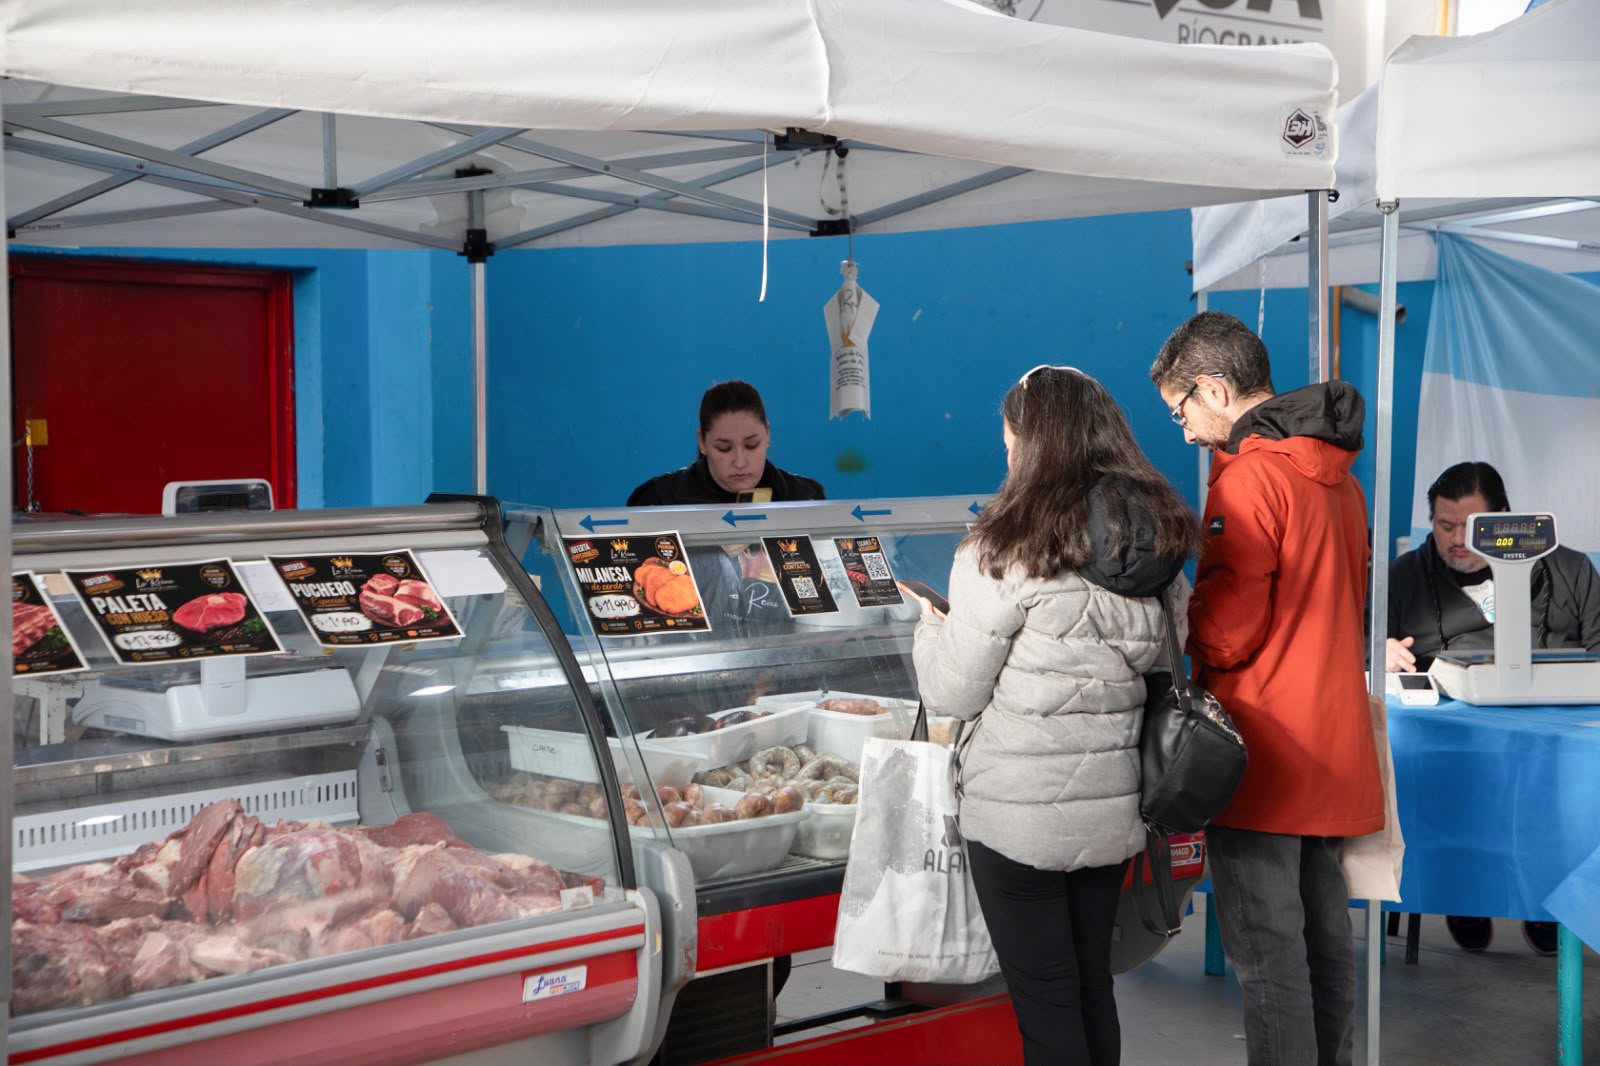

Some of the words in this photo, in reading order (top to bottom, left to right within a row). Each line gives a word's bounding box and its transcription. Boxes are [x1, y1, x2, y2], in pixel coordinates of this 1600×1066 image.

[575, 566, 632, 583] MILANESA
[289, 581, 356, 598] PUCHERO
[591, 582, 601, 590] de
[602, 580, 624, 590] cerdo
[91, 593, 167, 614] PALETA
[533, 975, 567, 995] Luana
